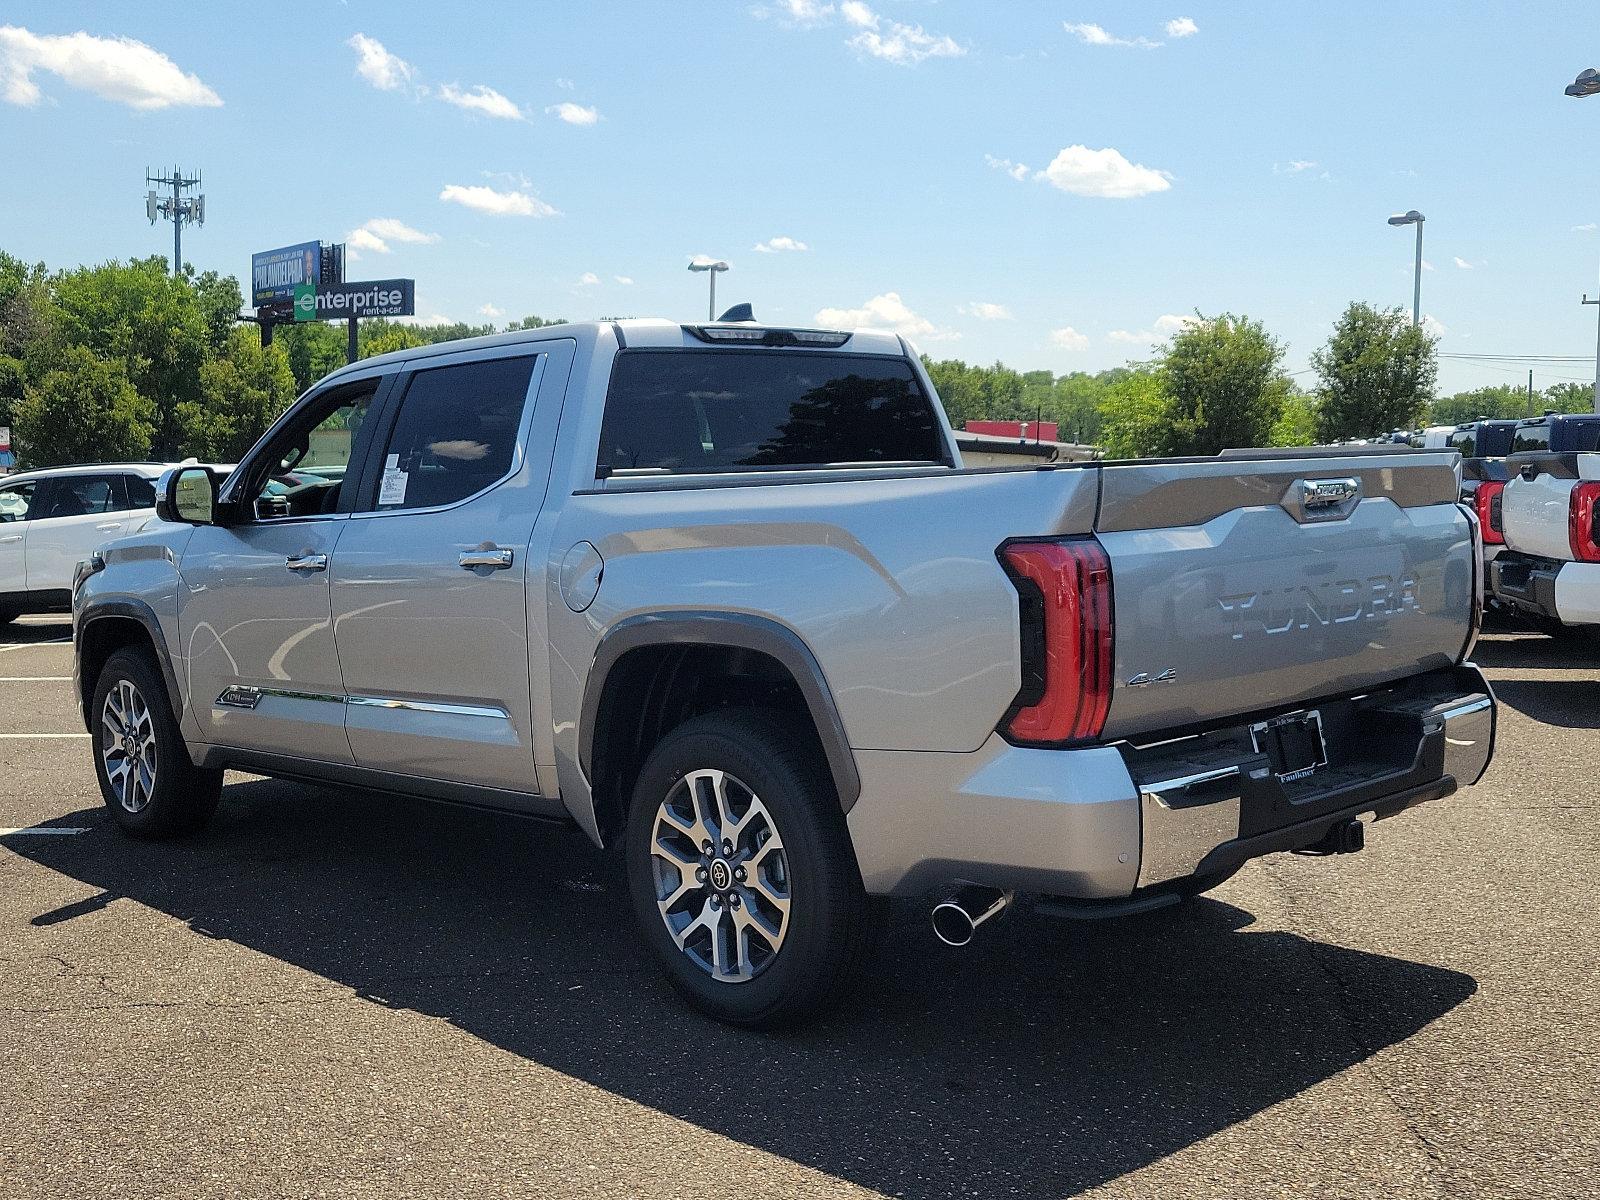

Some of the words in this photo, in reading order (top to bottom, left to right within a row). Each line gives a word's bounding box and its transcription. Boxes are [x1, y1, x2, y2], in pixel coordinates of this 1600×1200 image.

[297, 286, 403, 313] enterprise
[362, 305, 402, 316] rent-a-car
[1217, 571, 1424, 639] TUNDRA
[1280, 769, 1315, 783] Faulkner
